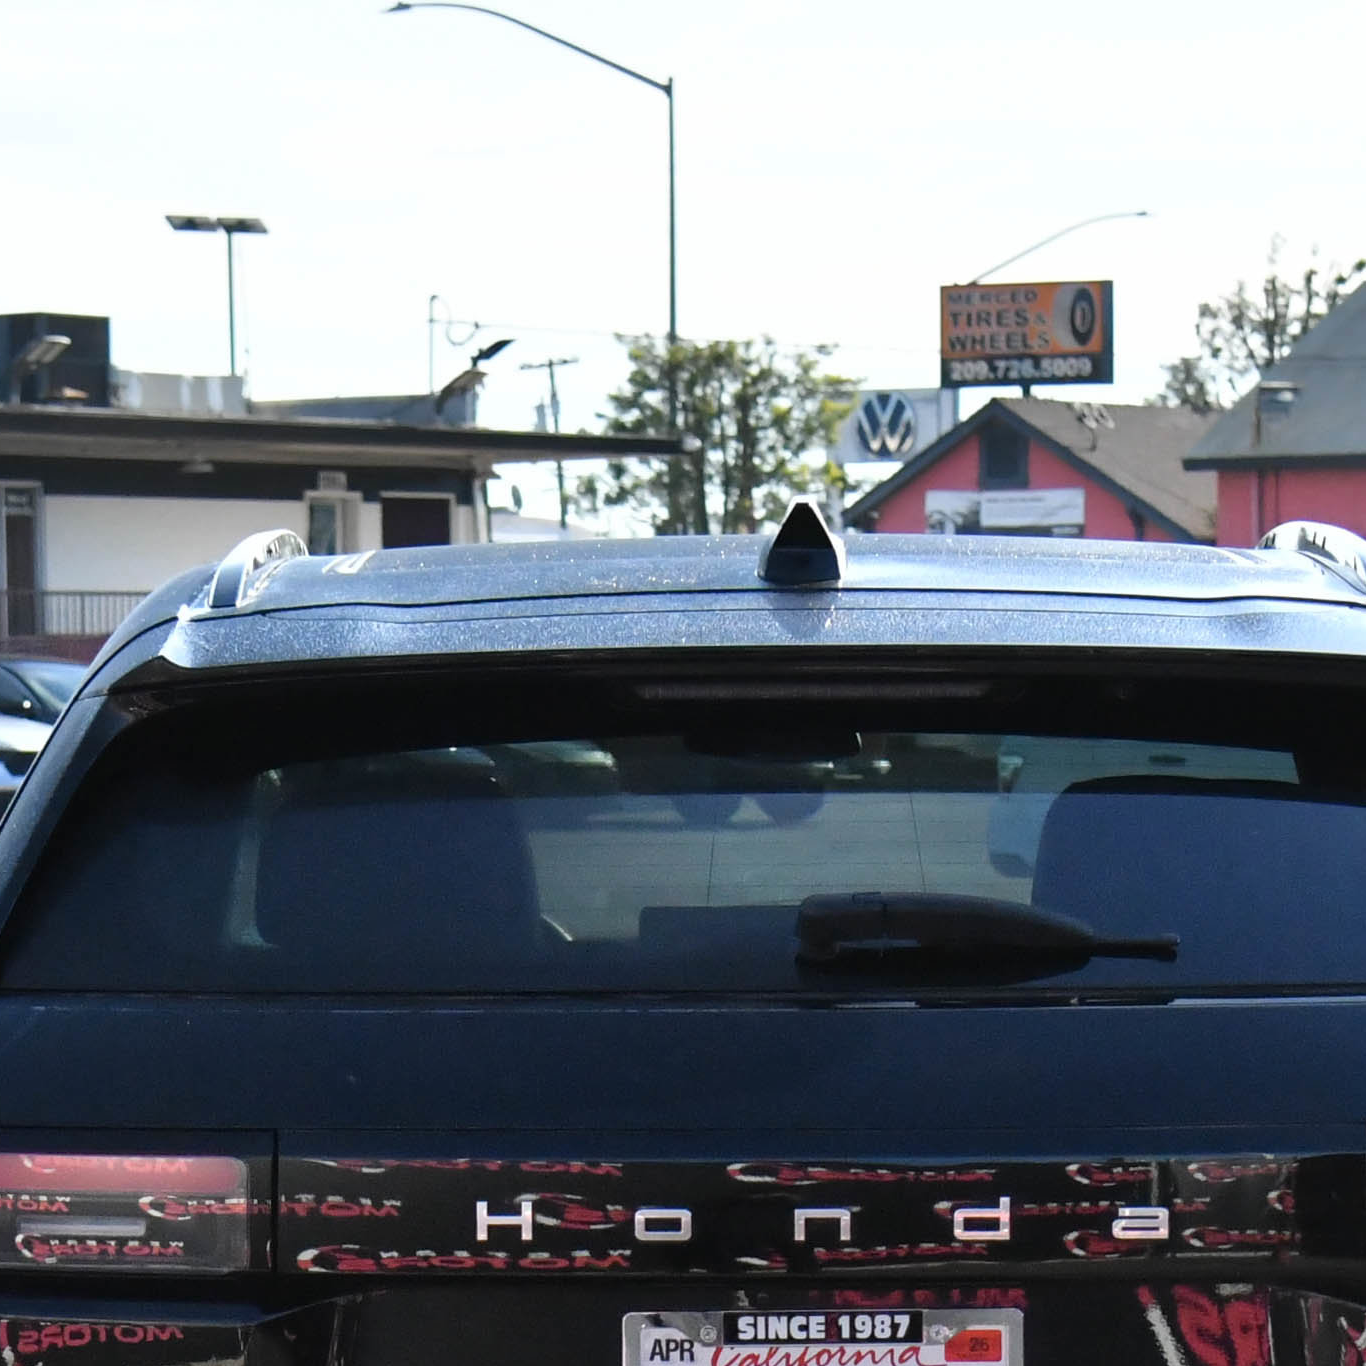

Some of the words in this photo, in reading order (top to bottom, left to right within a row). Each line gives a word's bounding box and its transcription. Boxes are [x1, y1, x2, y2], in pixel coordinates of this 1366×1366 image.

[949, 308, 1030, 328] TIRES
[948, 331, 1051, 352] WHEELS
[737, 1314, 825, 1340] SINCE
[838, 1314, 911, 1339] 1987
[649, 1338, 695, 1362] APR
